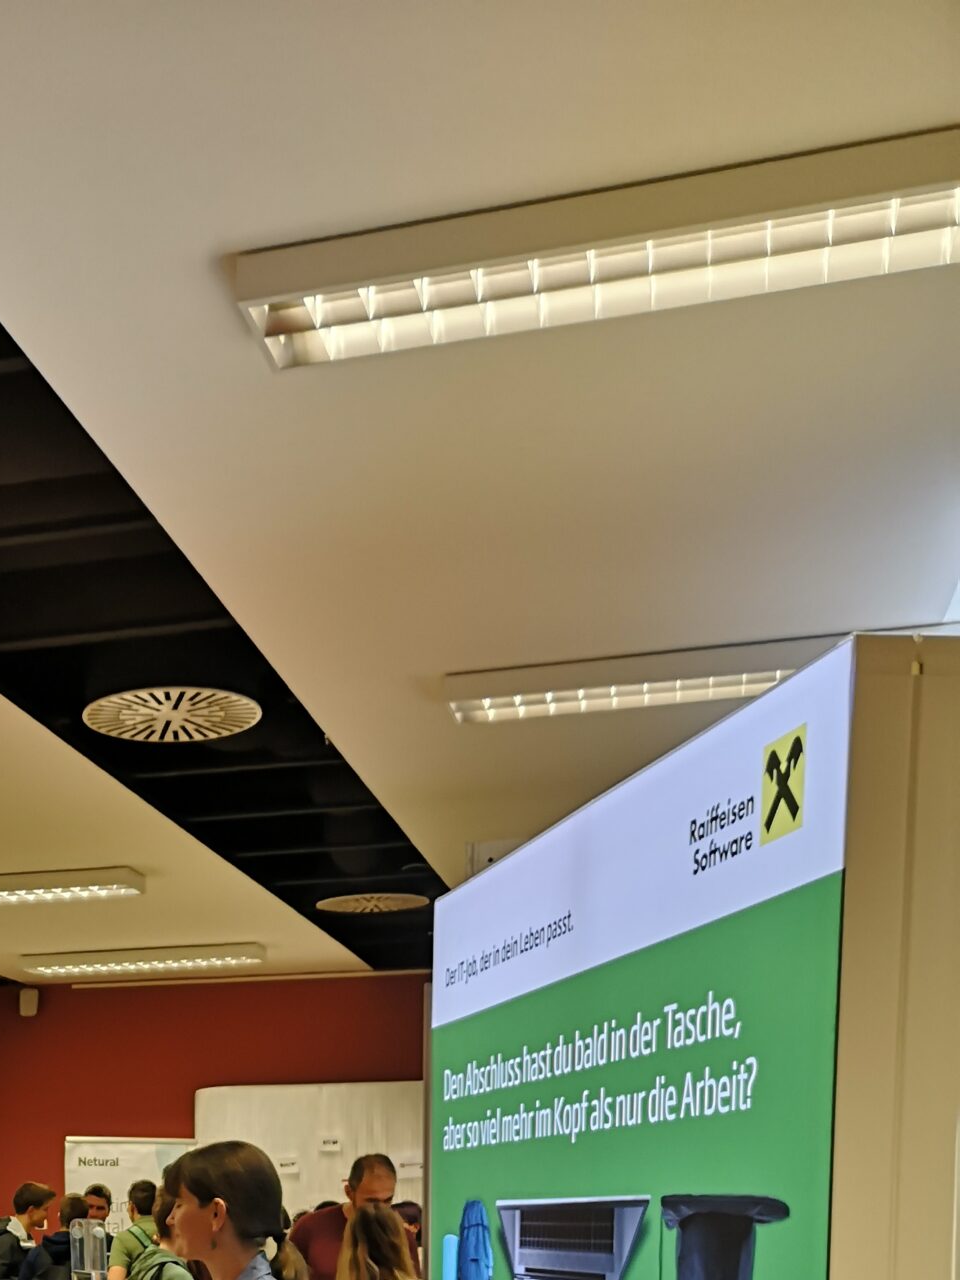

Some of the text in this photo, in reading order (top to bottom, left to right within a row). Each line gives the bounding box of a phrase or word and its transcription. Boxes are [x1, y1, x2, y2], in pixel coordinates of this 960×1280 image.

[689, 795, 754, 846] Raiffeisen
[693, 831, 753, 876] Software
[445, 968, 457, 988] Der
[479, 950, 492, 972] der
[493, 945, 500, 967] in
[501, 936, 518, 963] dein
[520, 926, 545, 954] Leben
[546, 910, 574, 948] passt.
[443, 990, 742, 1101] Den Abschluss hast du bald in der Tasche,
[443, 1056, 758, 1150] aber so viel mehr im Kopf als nur die Arbeit?
[78, 1156, 119, 1168] Netural
